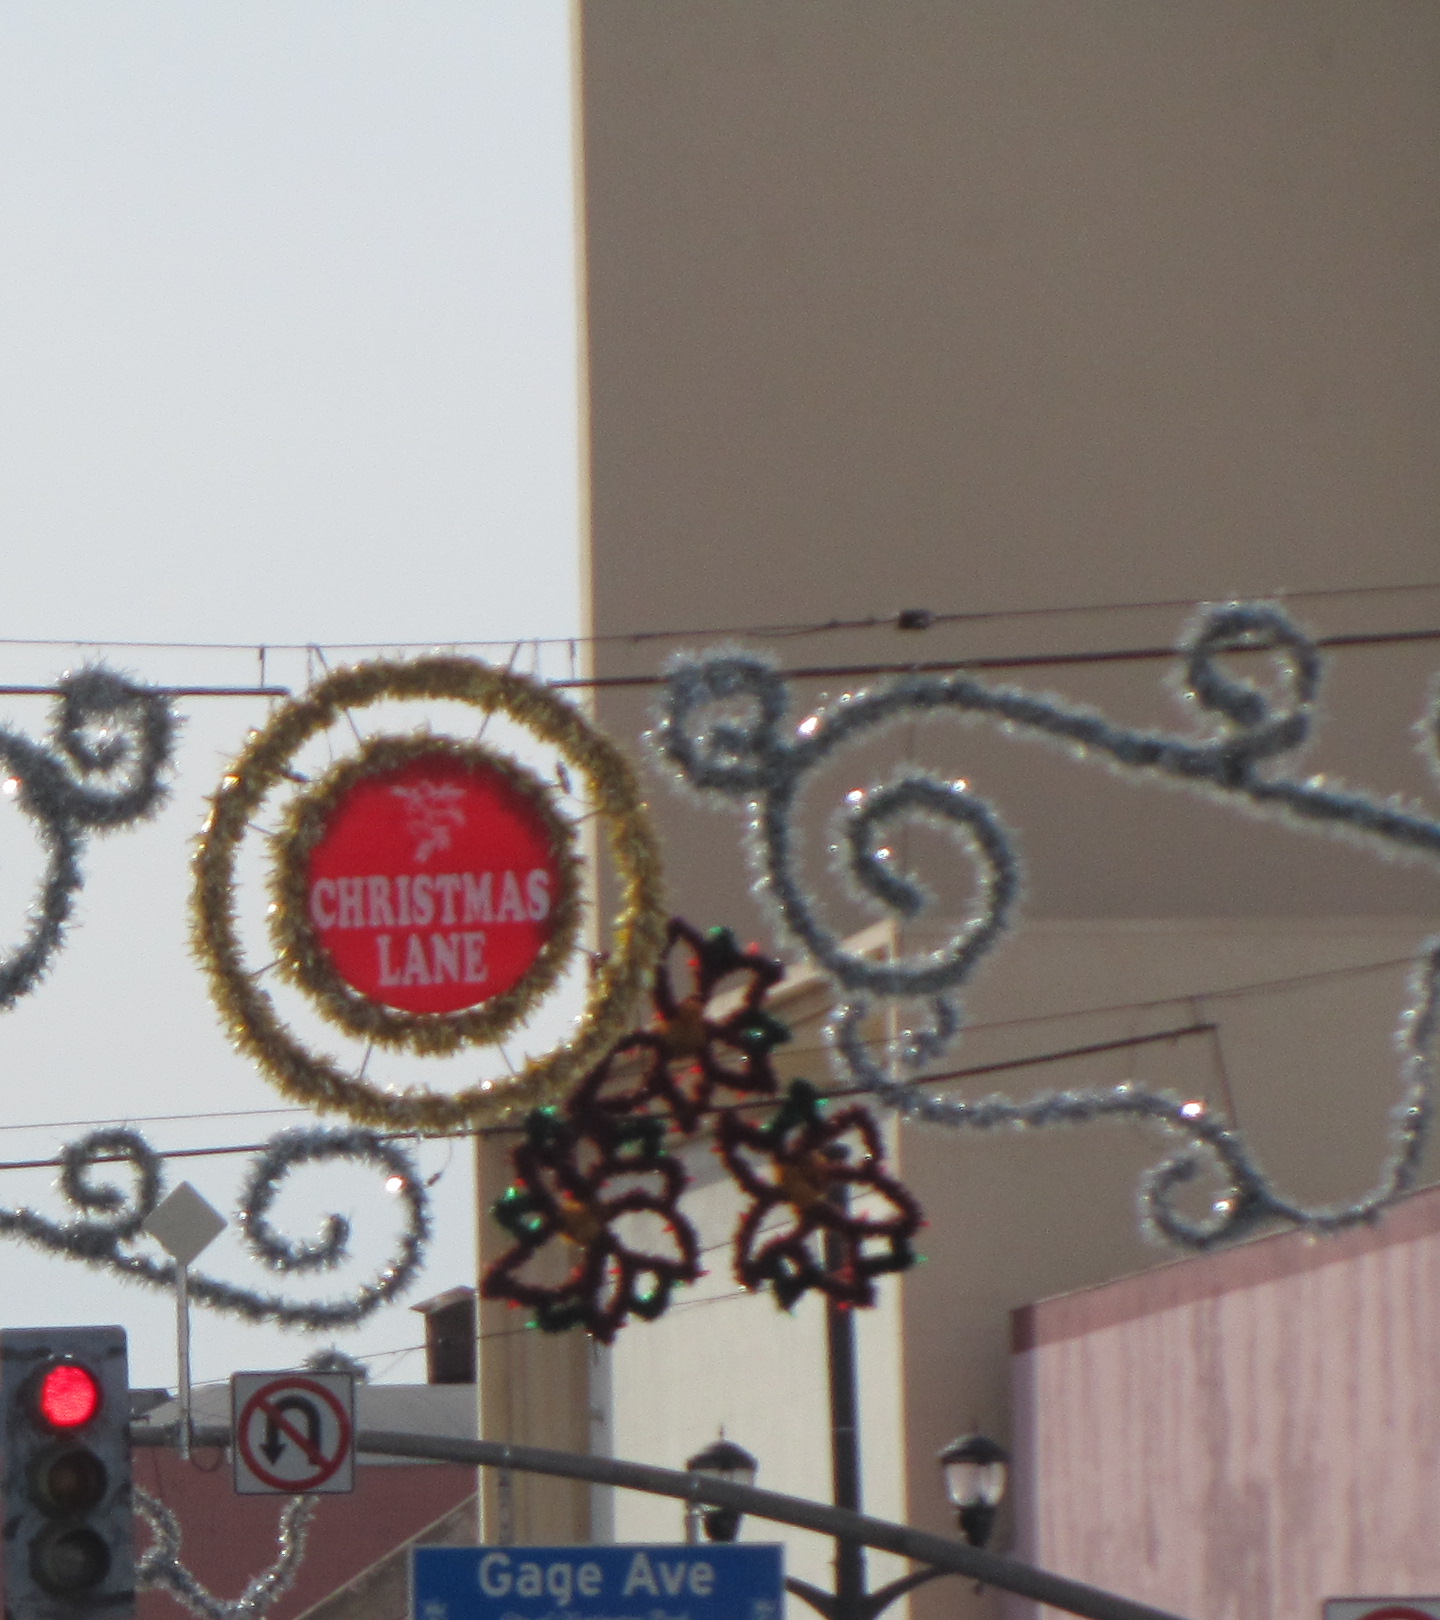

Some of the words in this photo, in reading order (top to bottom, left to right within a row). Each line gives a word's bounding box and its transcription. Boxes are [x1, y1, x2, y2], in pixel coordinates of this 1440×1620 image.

[310, 867, 551, 930] CHRISTMAS
[375, 930, 489, 988] LANE
[477, 1551, 604, 1607] Gage
[623, 1551, 717, 1597] Ave
